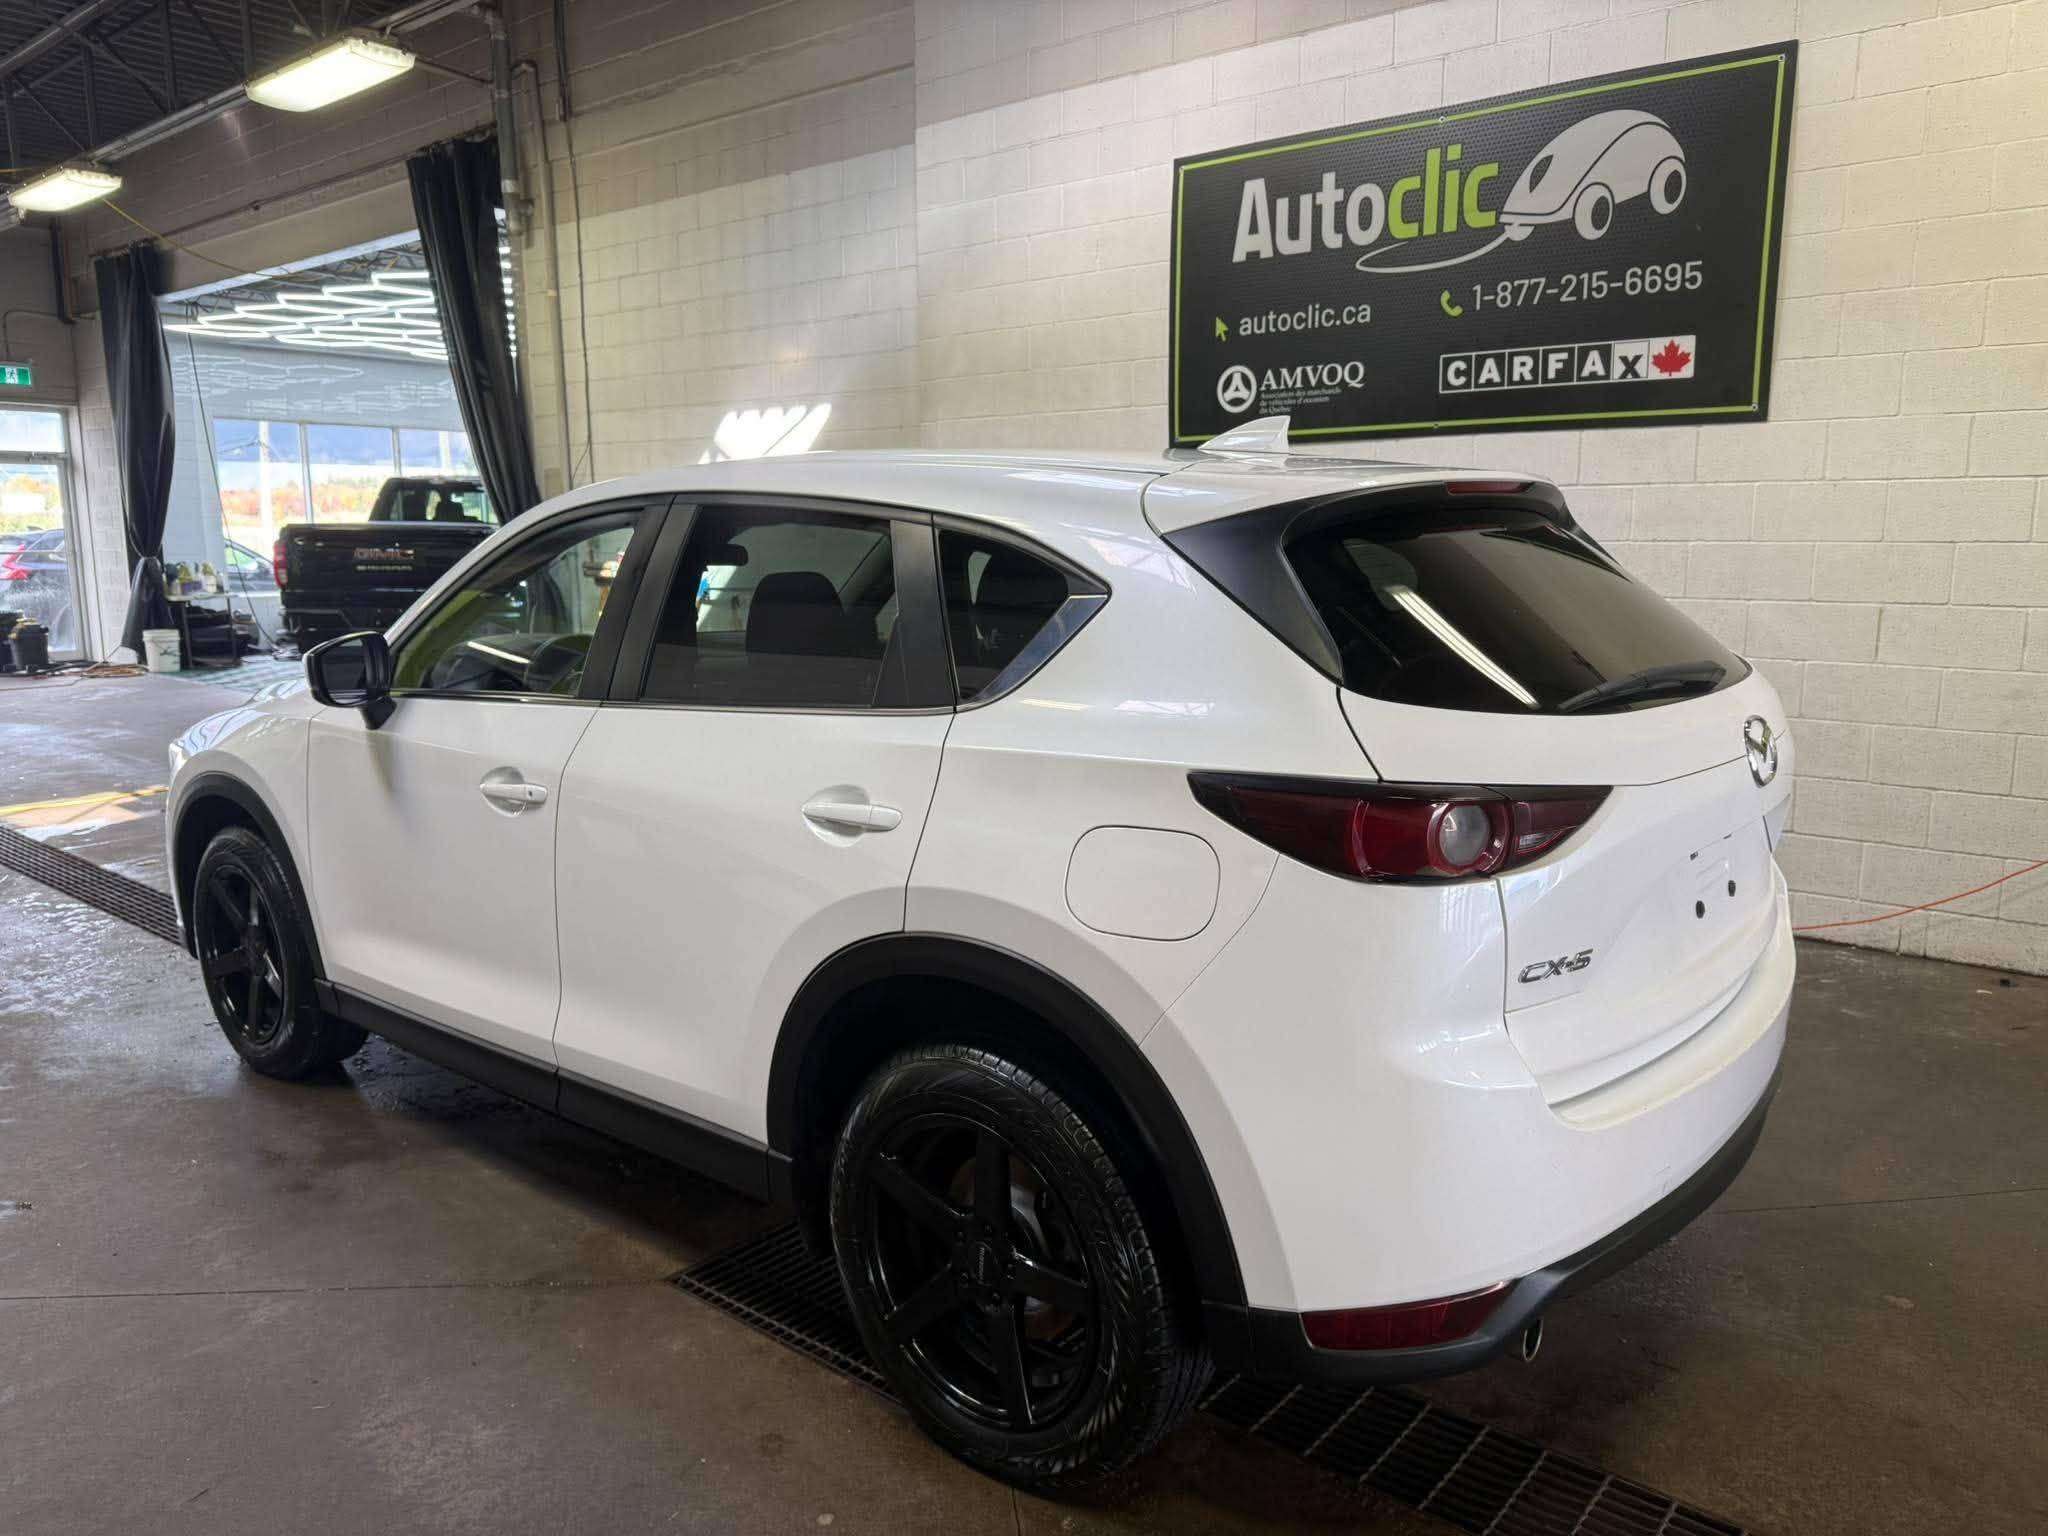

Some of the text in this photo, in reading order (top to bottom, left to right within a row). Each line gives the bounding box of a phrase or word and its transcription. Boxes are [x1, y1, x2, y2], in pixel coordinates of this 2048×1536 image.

[1232, 143, 1499, 263] Autoclic
[1472, 261, 1703, 311] 1-877-215-6695
[1239, 303, 1371, 336] autoclic.ca
[1259, 361, 1365, 391] AMVOQ
[1446, 350, 1644, 387] CARFAX
[1518, 948, 1594, 983] CX-5
